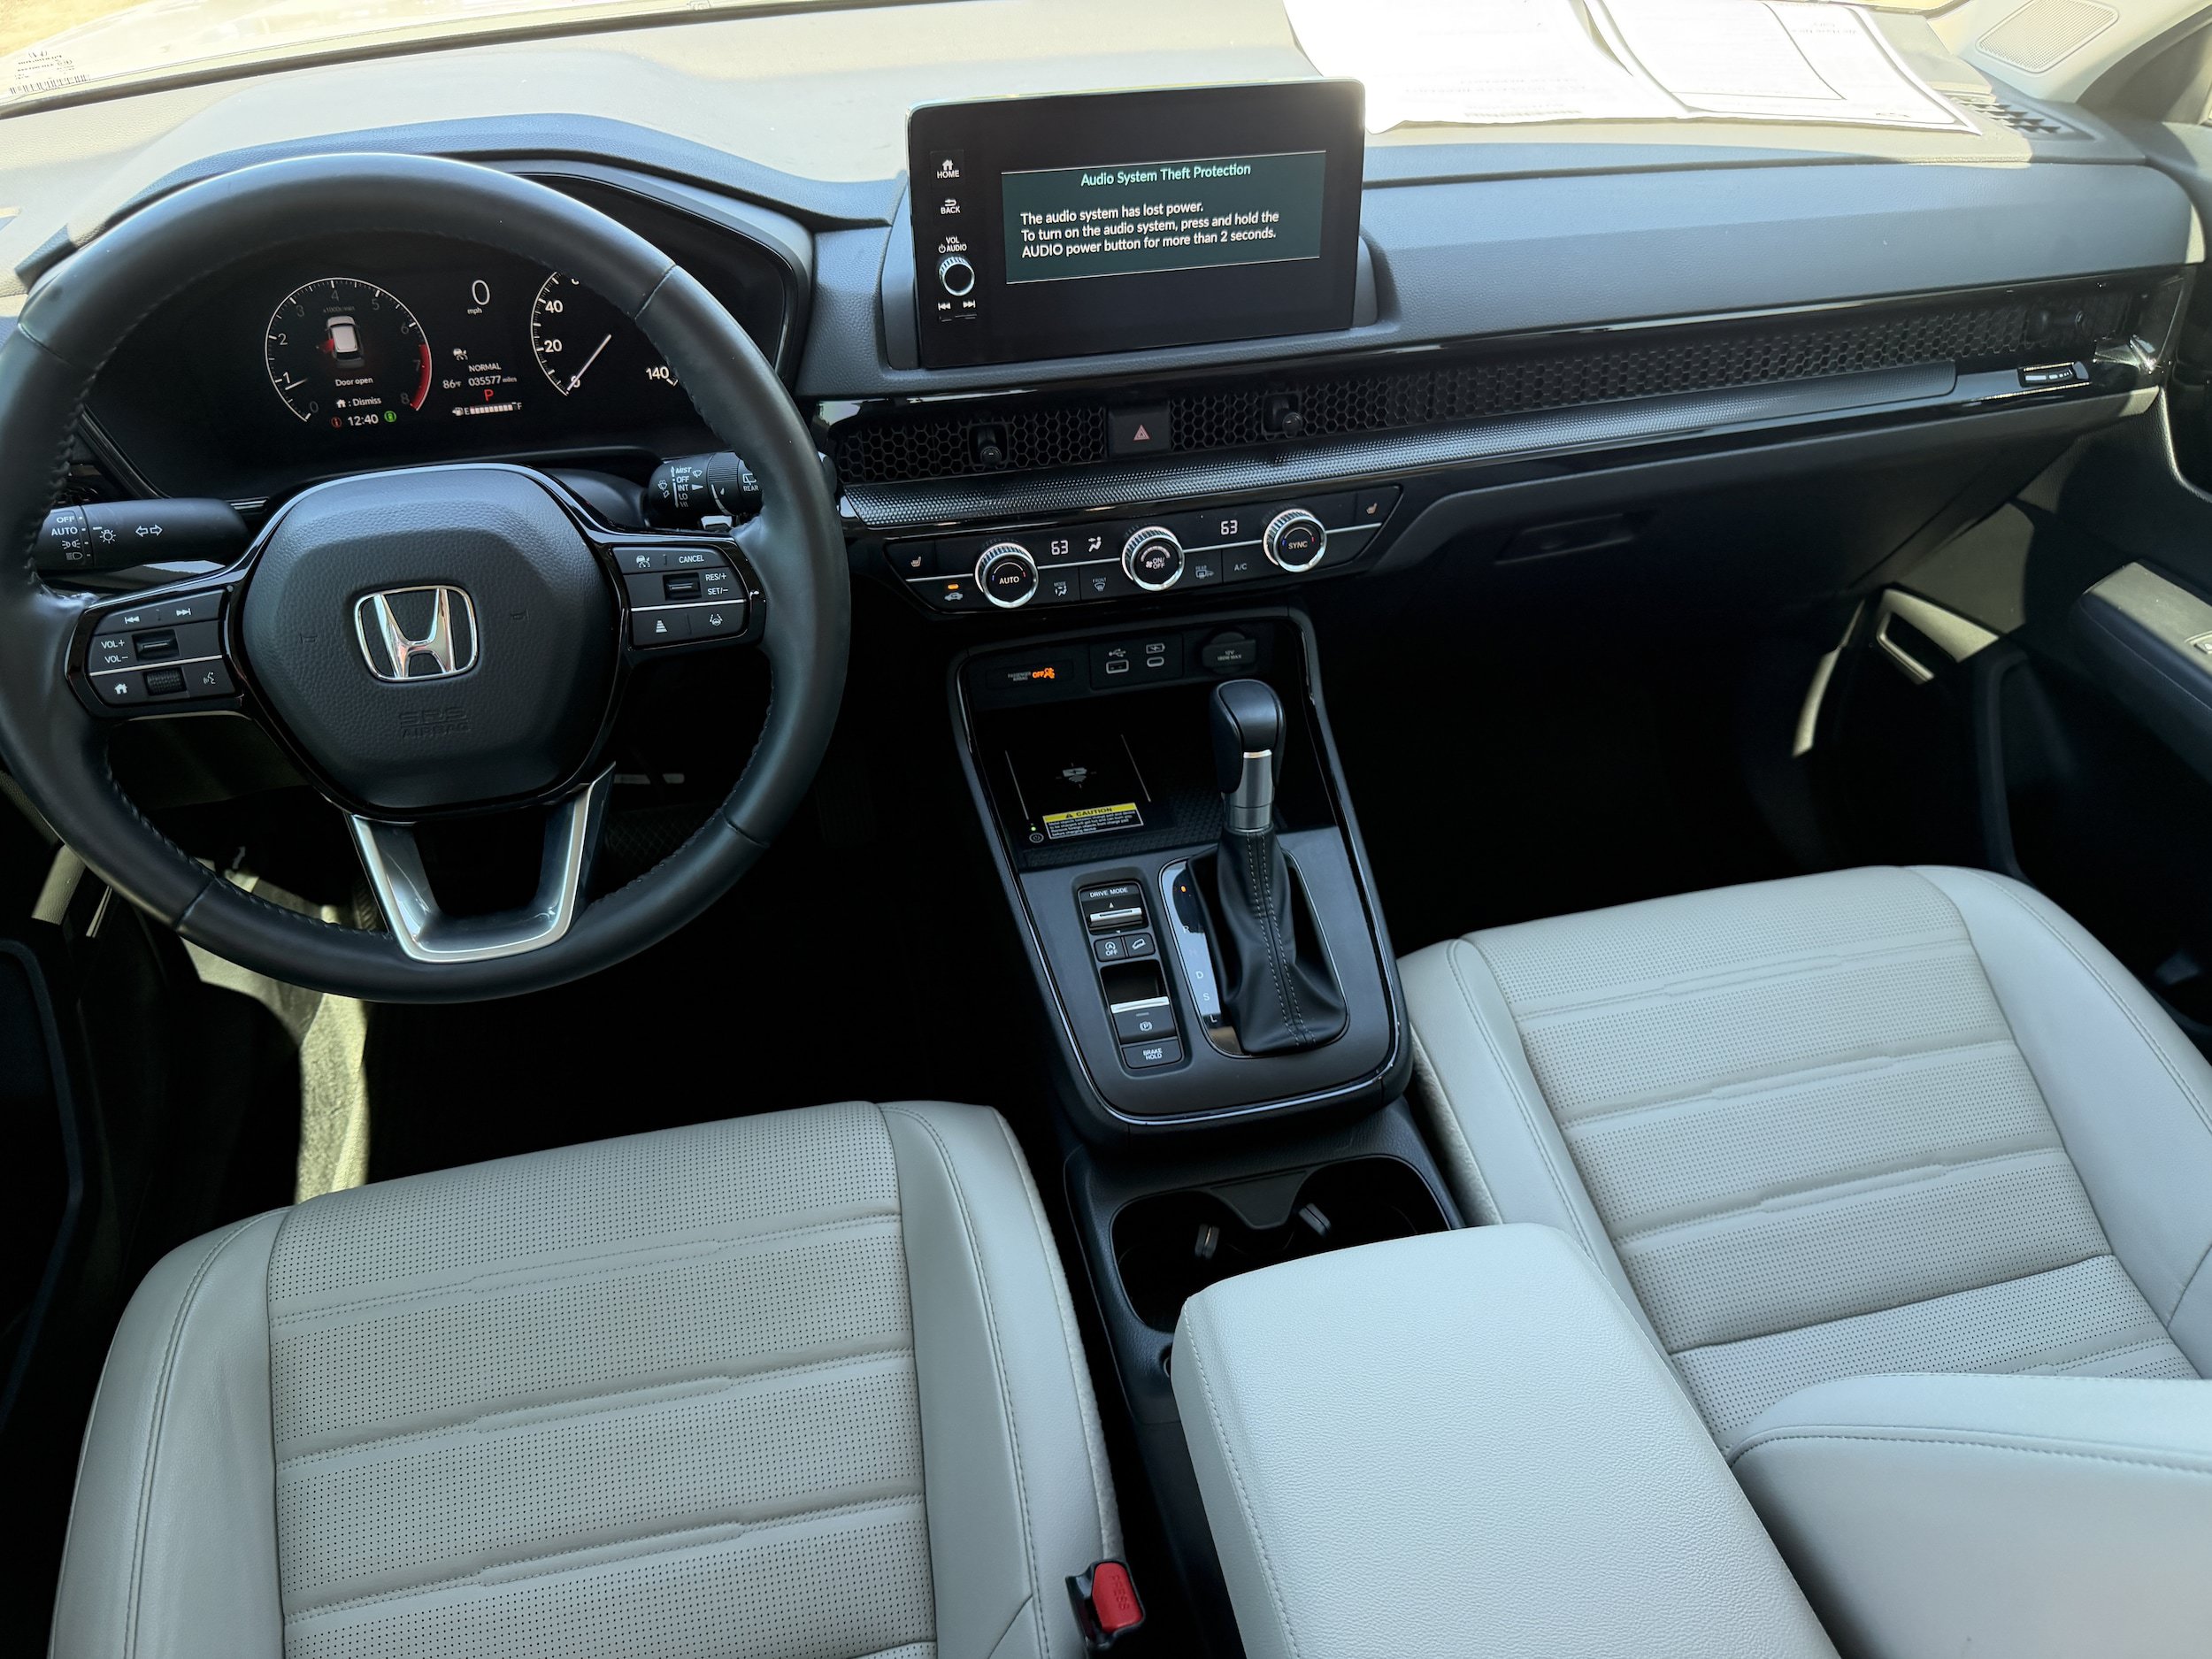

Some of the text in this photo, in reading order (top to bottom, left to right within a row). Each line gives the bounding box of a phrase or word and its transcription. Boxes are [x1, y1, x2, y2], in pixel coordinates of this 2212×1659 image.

[936, 170, 960, 179] HOME
[1080, 163, 1251, 187] Audio System Theft Protection
[941, 206, 961, 215] BACK
[1020, 202, 1204, 226] The audio system has lost power.
[1020, 210, 1279, 242] To turn on the audio system, press and hold the
[947, 243, 967, 252] AUDIO
[1022, 226, 1277, 258] AUDIO power button for more than 2 seconds.
[331, 290, 339, 301] 4
[472, 280, 490, 305] 0
[372, 299, 380, 310] 5
[545, 300, 563, 313] 40
[296, 305, 304, 317] 3
[401, 324, 409, 334] 6
[278, 334, 288, 345] 2
[544, 340, 562, 353] 20
[283, 372, 290, 383] 1
[646, 366, 669, 380] 140
[468, 375, 502, 387] 035577
[353, 396, 381, 406] Dismiss
[400, 393, 410, 404] 8
[484, 389, 494, 402] P
[310, 401, 319, 412] 0
[348, 414, 379, 426] 12:40
[51, 527, 78, 536] AUTO
[1220, 519, 1238, 535] 63
[1050, 540, 1069, 556] 63
[1288, 540, 1309, 549] SYNC
[679, 555, 704, 564] CANCEL
[1234, 563, 1248, 572] A/C
[999, 575, 1019, 585] AUTO
[1076, 807, 1112, 817] CAUTION
[1089, 889, 1109, 898] DRIVE
[1196, 971, 1204, 979] D
[1210, 1014, 1217, 1023] L
